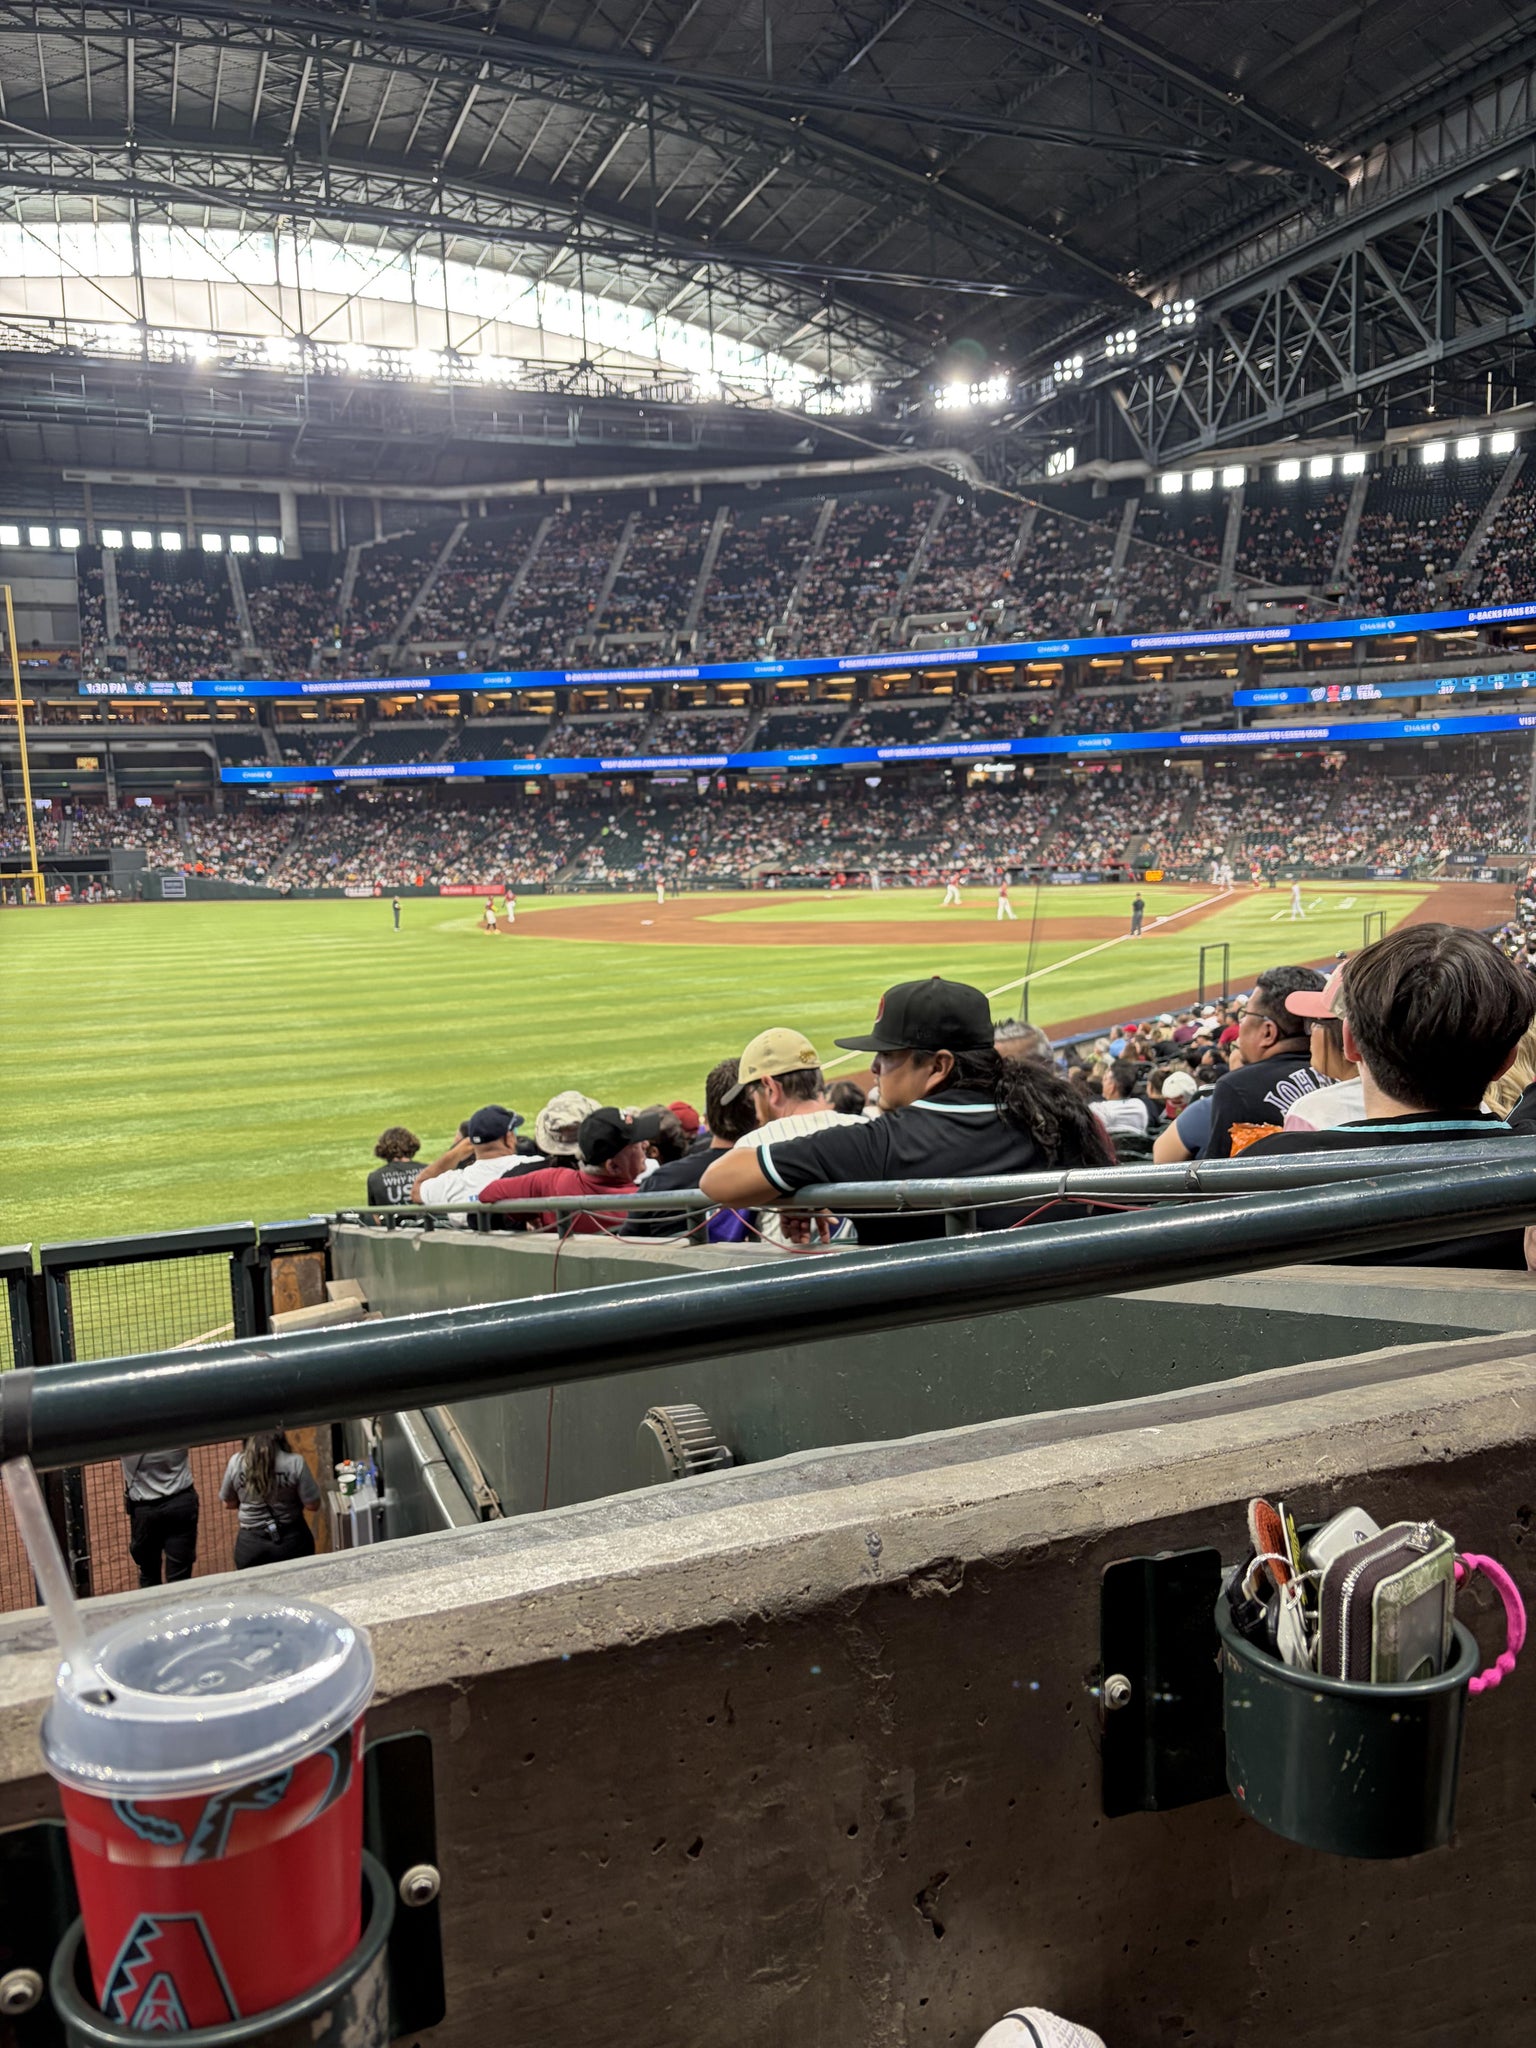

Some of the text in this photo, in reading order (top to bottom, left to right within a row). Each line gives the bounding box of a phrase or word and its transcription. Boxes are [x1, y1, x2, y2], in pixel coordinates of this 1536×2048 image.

[1469, 605, 1536, 621] D-BACKS FANS EX
[109, 683, 127, 694] PM
[383, 1176, 406, 1186] WHY
[387, 1184, 412, 1203] US
